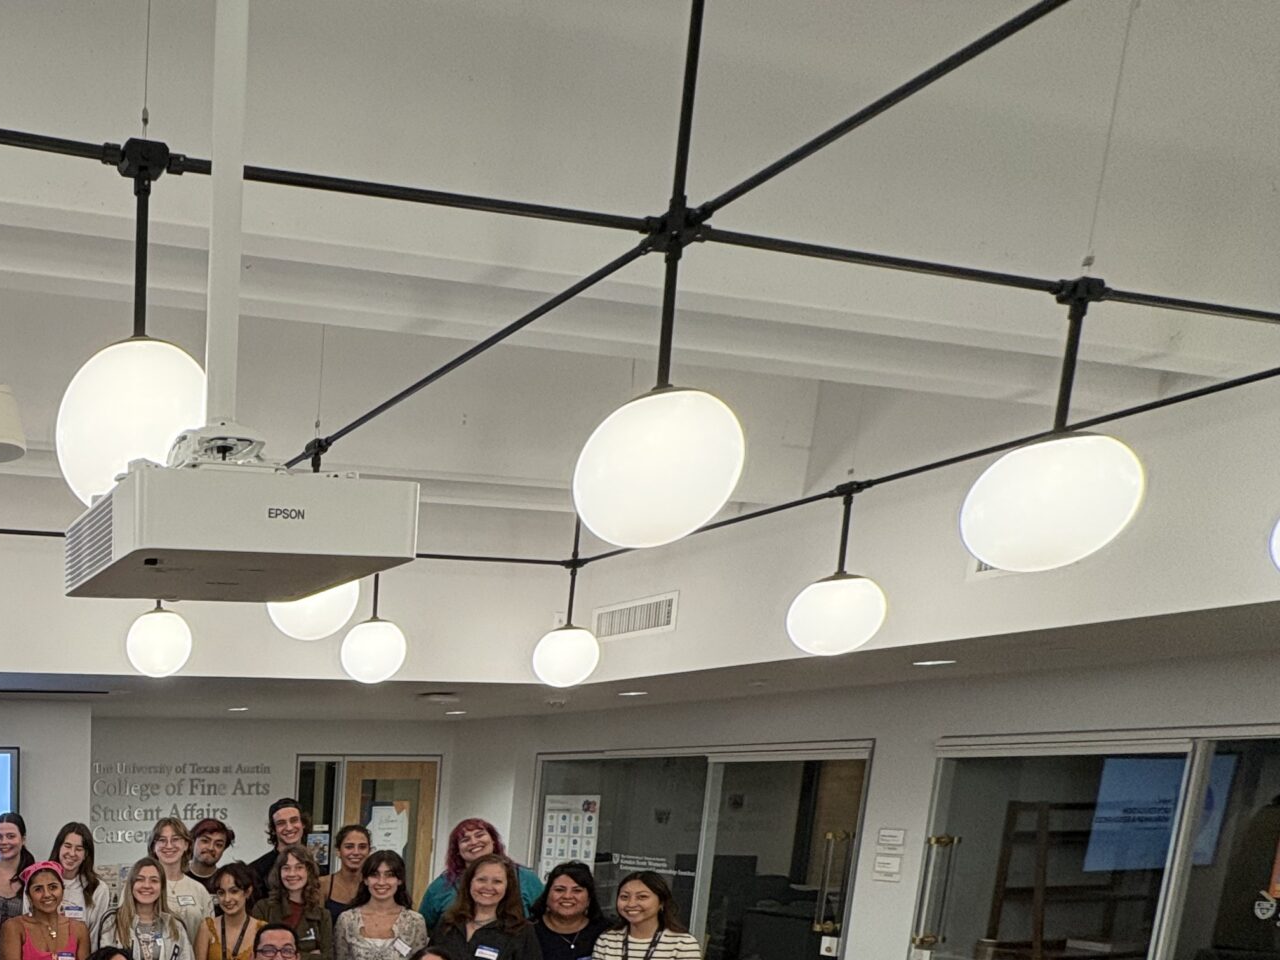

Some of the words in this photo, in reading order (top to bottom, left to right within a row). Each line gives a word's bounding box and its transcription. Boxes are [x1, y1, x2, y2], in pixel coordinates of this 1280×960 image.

[268, 507, 305, 520] EPSON
[93, 762, 114, 775] The
[116, 762, 173, 777] University
[175, 762, 187, 775] of
[189, 763, 221, 775] Texas
[223, 764, 232, 775] at
[233, 763, 271, 775] Austin
[92, 779, 161, 801] College
[165, 779, 186, 796] of
[189, 778, 228, 796] Fine
[231, 778, 270, 797] Arts
[91, 803, 161, 822] Student
[169, 803, 228, 820] Affairs
